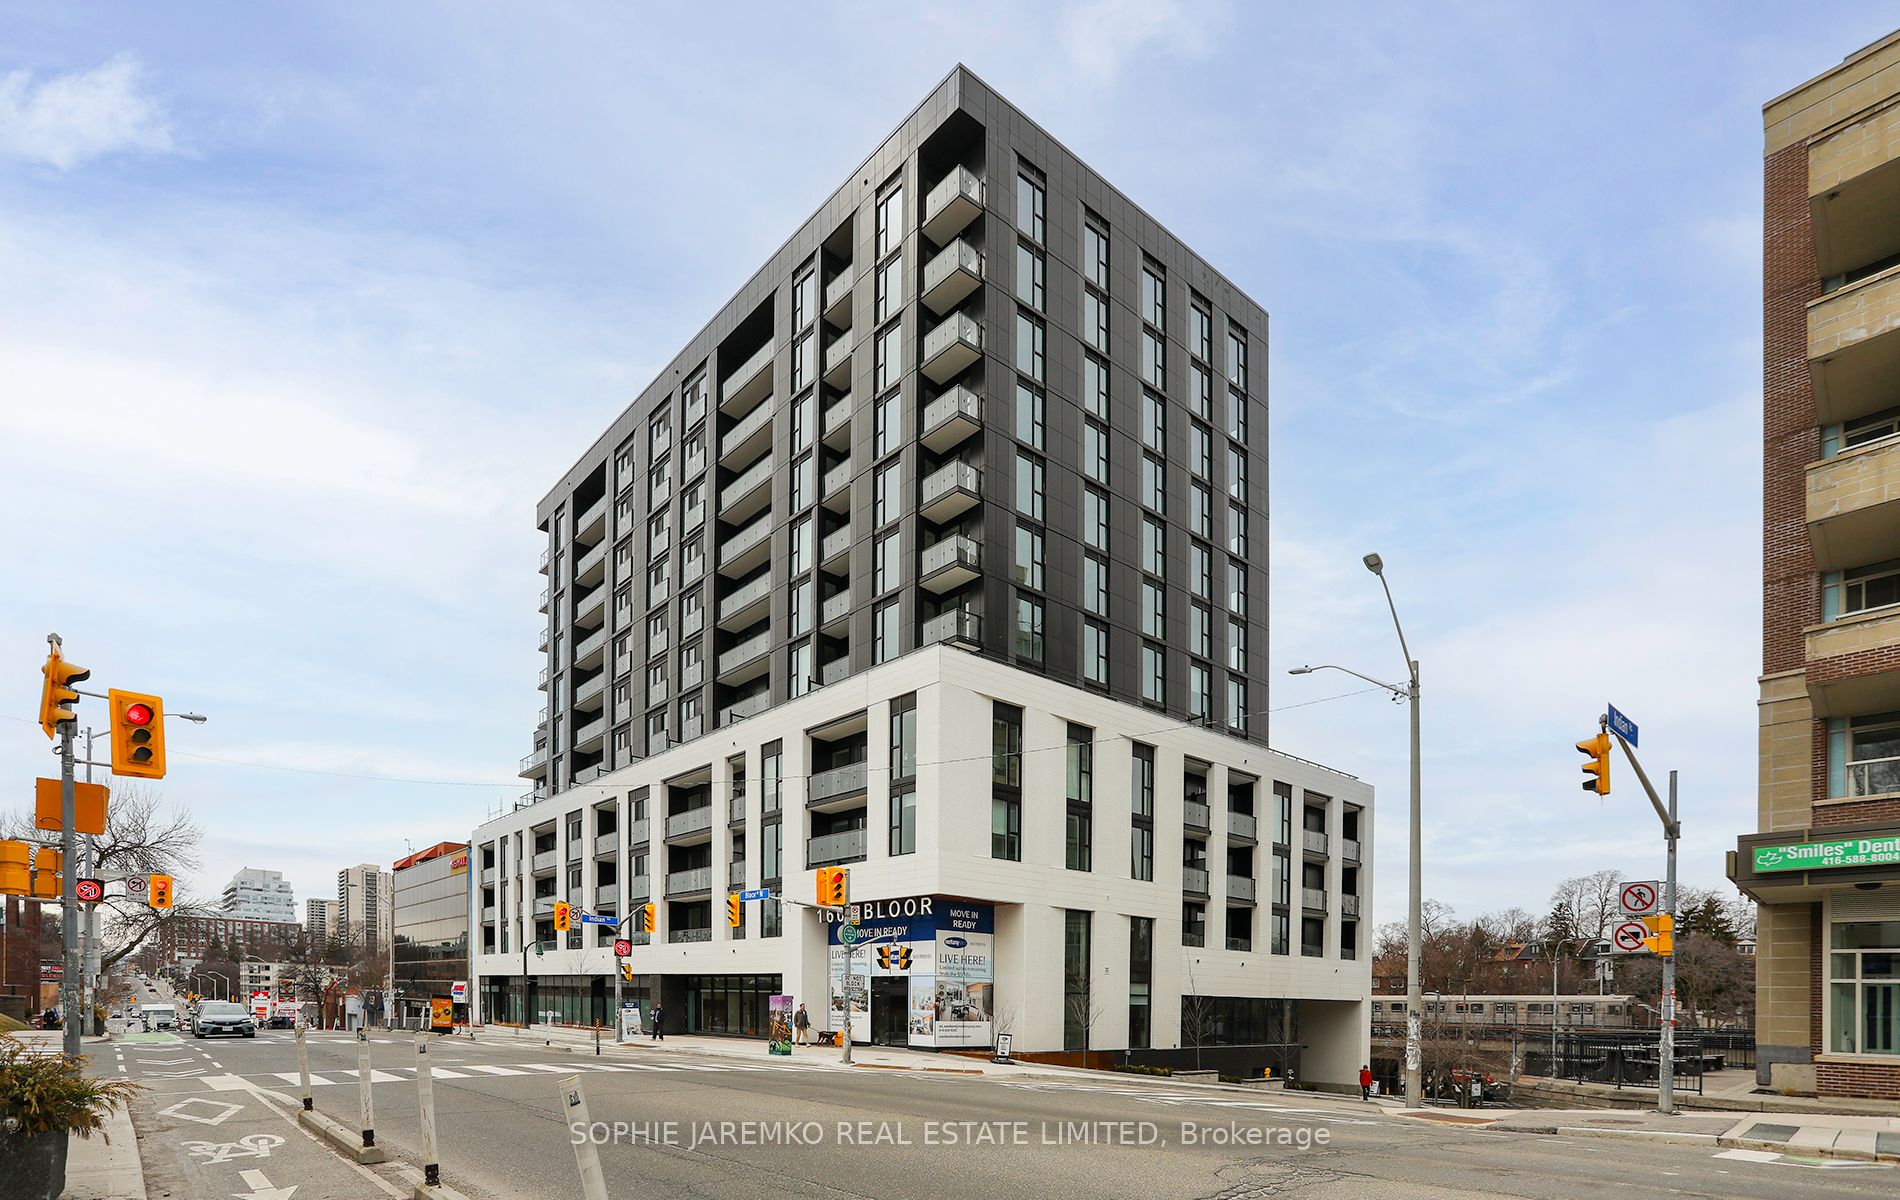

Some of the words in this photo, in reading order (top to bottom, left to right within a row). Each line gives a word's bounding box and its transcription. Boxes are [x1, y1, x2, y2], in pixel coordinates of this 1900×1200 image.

[1778, 841, 1853, 859] "Smiles"
[1821, 852, 1900, 866] 416-588-8004
[863, 897, 933, 920] BLOOR
[949, 909, 970, 919] MOVE
[971, 911, 979, 920] IN
[874, 927, 883, 937] IN
[884, 925, 908, 936] READY
[952, 920, 977, 929] READY
[939, 953, 959, 965] LIVE
[960, 954, 986, 966] HERE!
